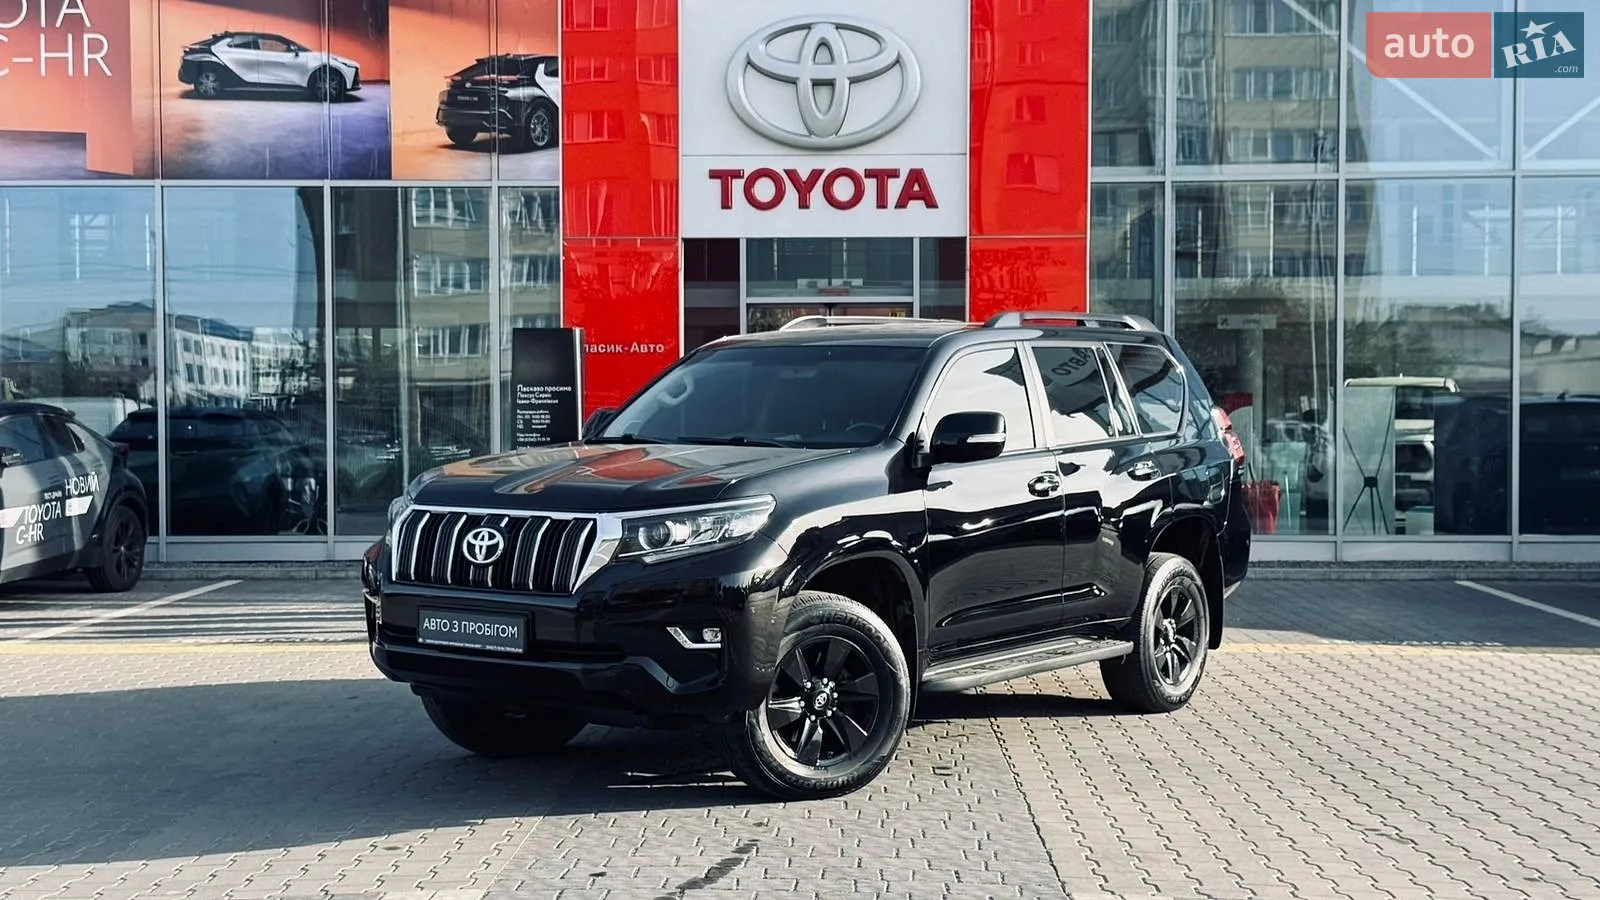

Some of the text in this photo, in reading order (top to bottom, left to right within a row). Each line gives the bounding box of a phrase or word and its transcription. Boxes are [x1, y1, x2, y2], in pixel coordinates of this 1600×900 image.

[0, 32, 113, 77] -HR
[708, 167, 939, 211] TOYOTA
[65, 471, 100, 496] НОВИЙ
[22, 500, 62, 525] TOYOTA
[16, 522, 45, 545] C-HR
[423, 618, 450, 632] АВТО
[461, 621, 518, 638] ПРОБІГОМ
